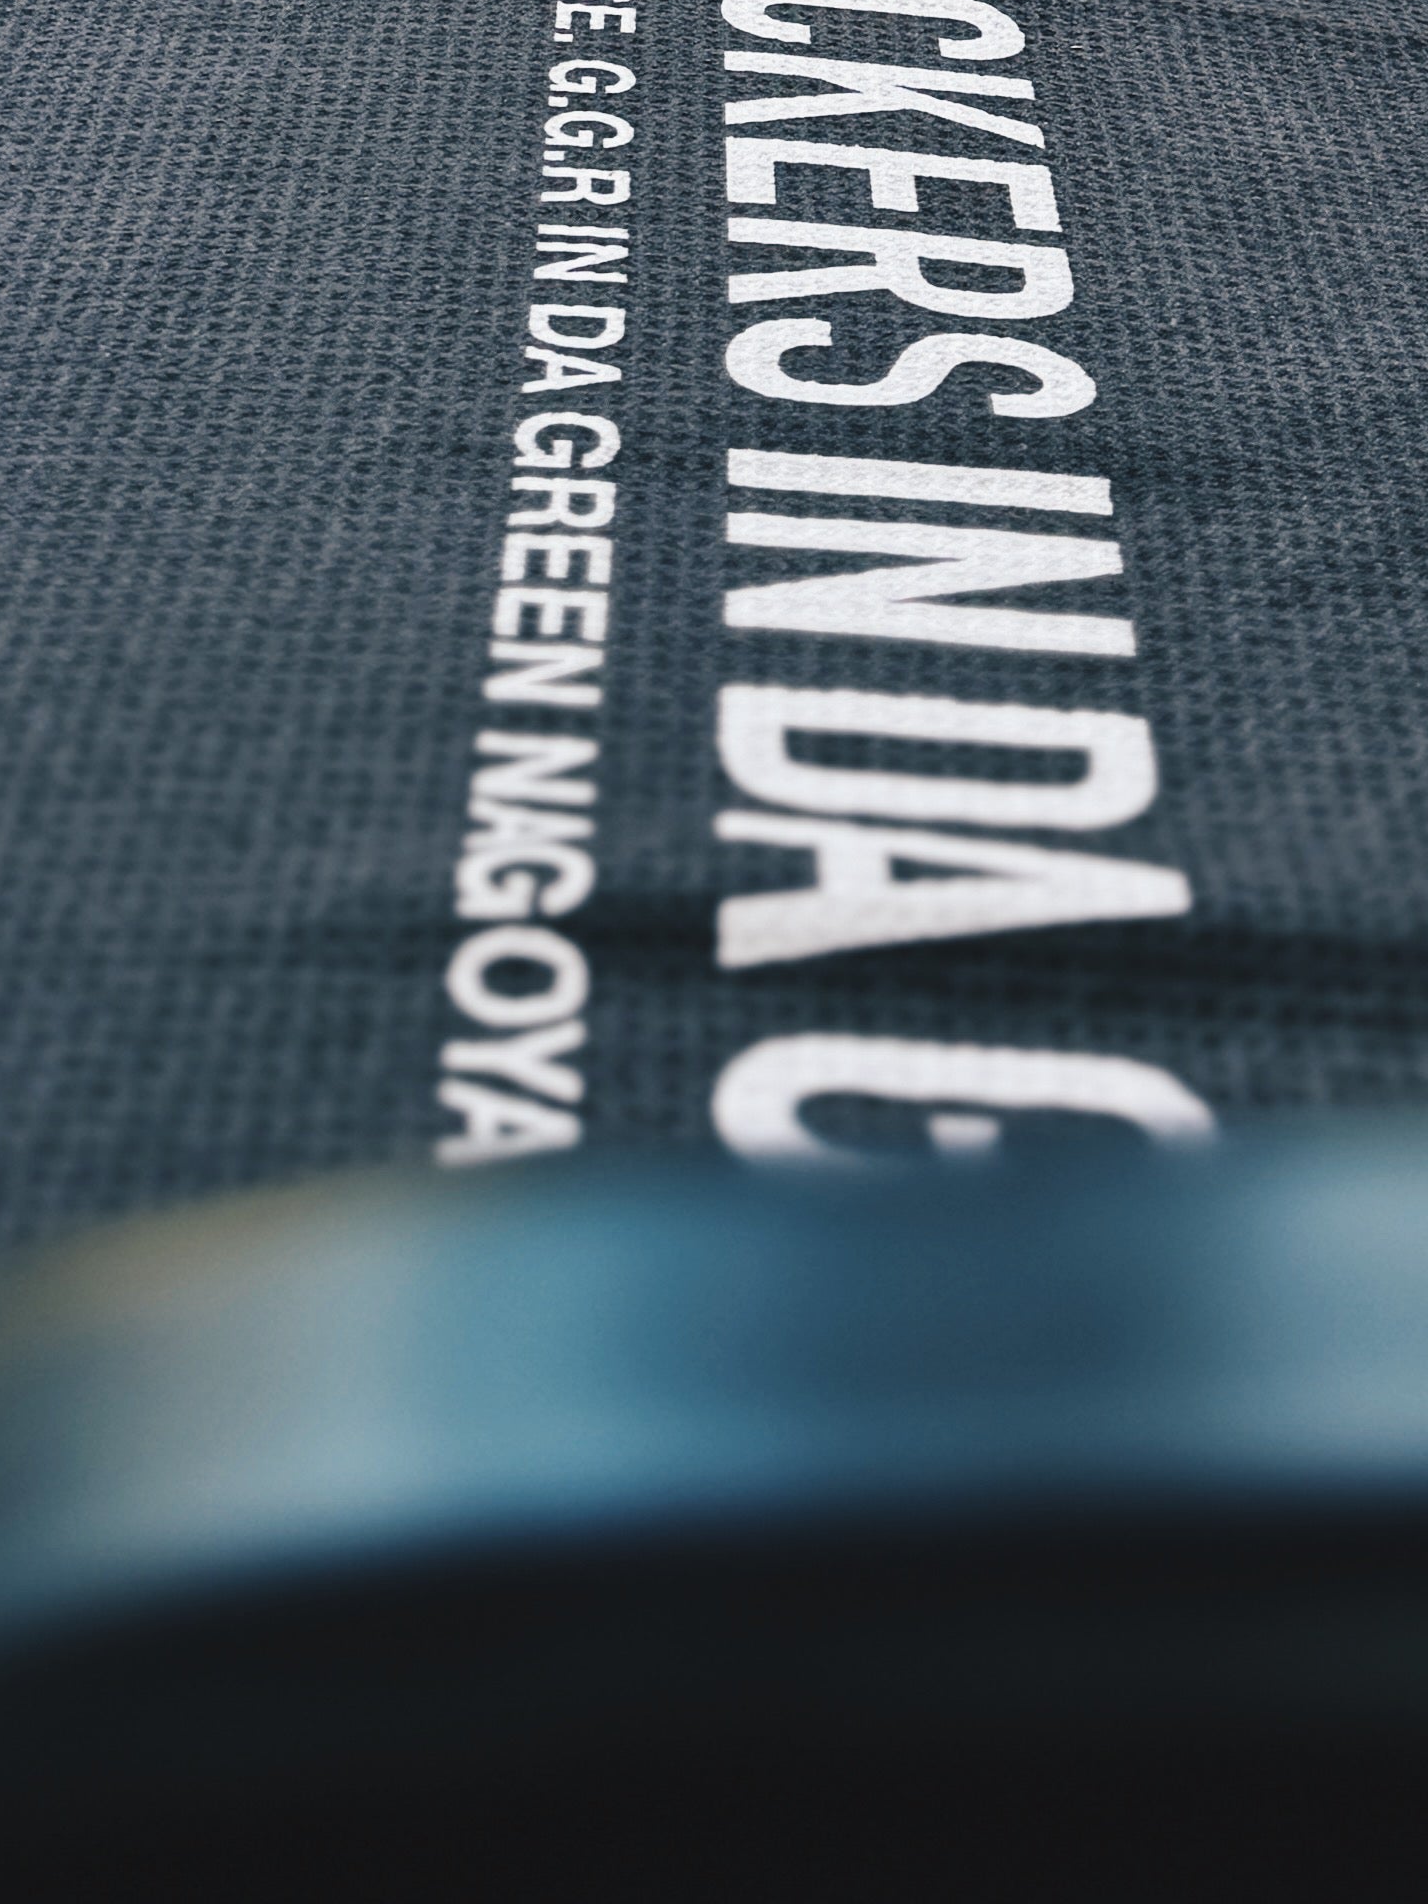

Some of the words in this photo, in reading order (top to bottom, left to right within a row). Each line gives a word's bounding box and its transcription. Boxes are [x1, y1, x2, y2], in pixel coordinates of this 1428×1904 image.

[538, 58, 637, 206] G.G.R
[520, 303, 627, 394] DA
[532, 223, 630, 283] IN
[482, 411, 621, 706] GREEN
[722, 448, 1137, 657] IN
[714, 682, 1192, 967] DA
[436, 730, 598, 1168] NAGOYA
